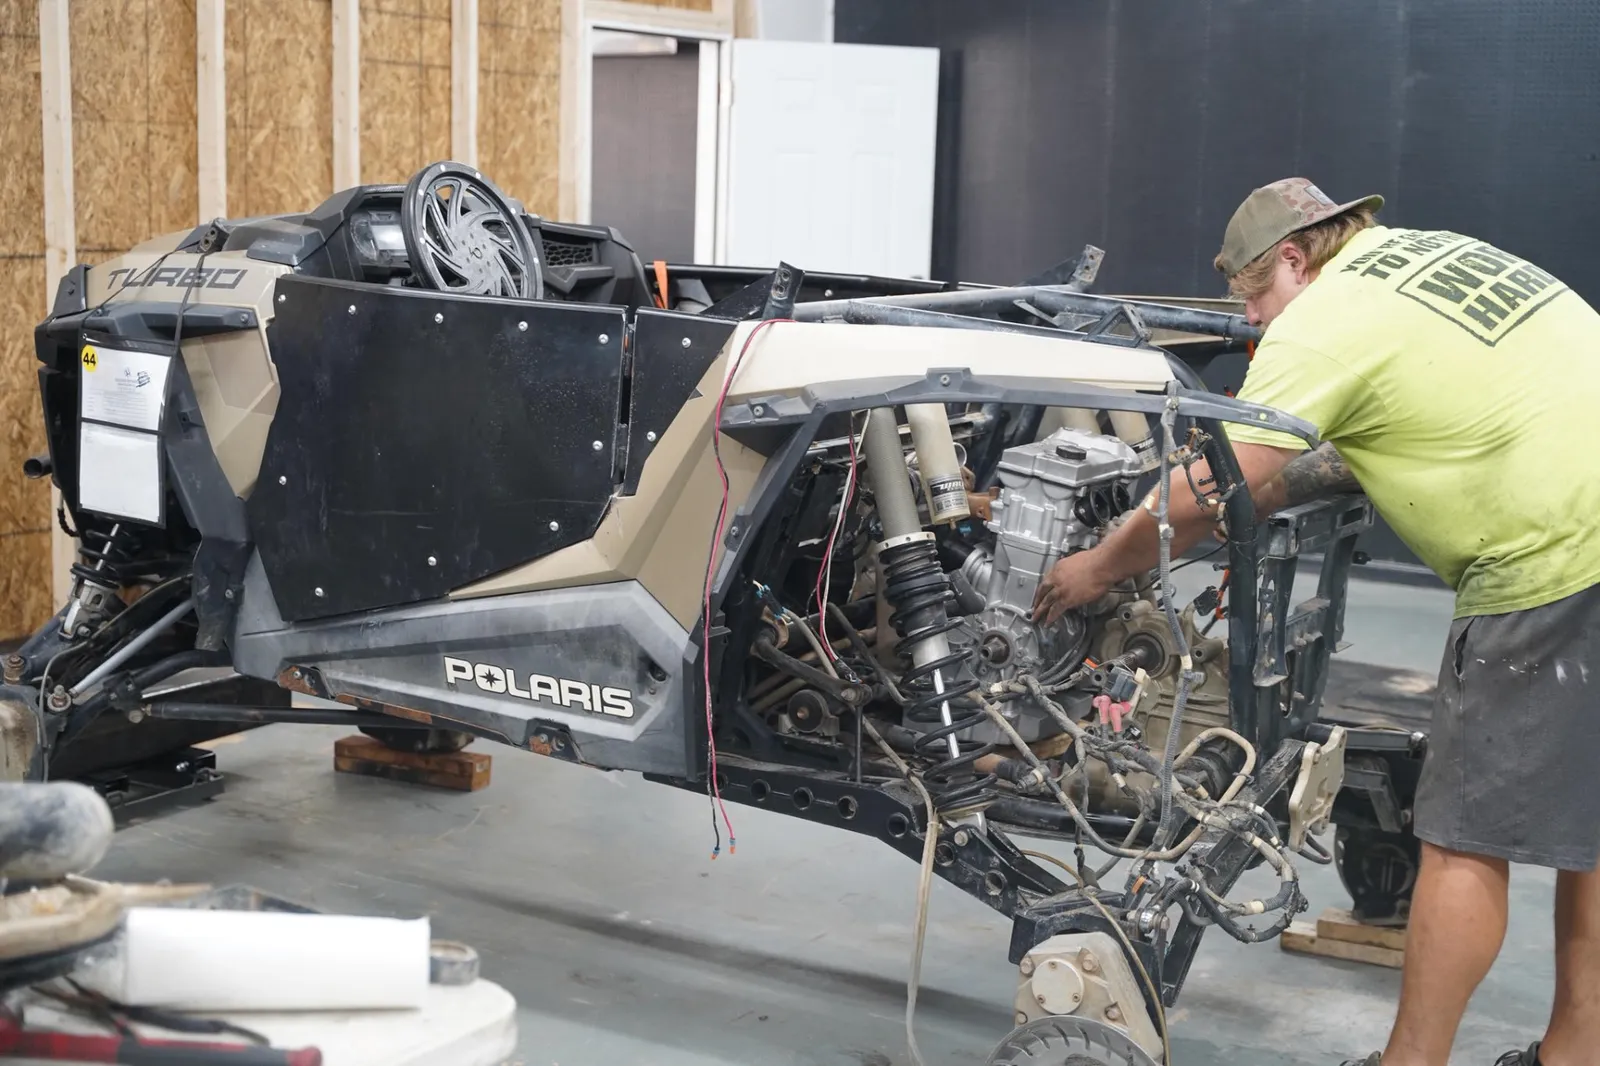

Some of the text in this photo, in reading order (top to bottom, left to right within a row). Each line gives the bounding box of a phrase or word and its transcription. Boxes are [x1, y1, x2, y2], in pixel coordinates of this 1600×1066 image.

[107, 267, 249, 290] TURBO
[1360, 253, 1411, 280] TO
[1417, 245, 1519, 304] WOR
[83, 352, 97, 366] 44
[443, 655, 635, 718] POLARIS
